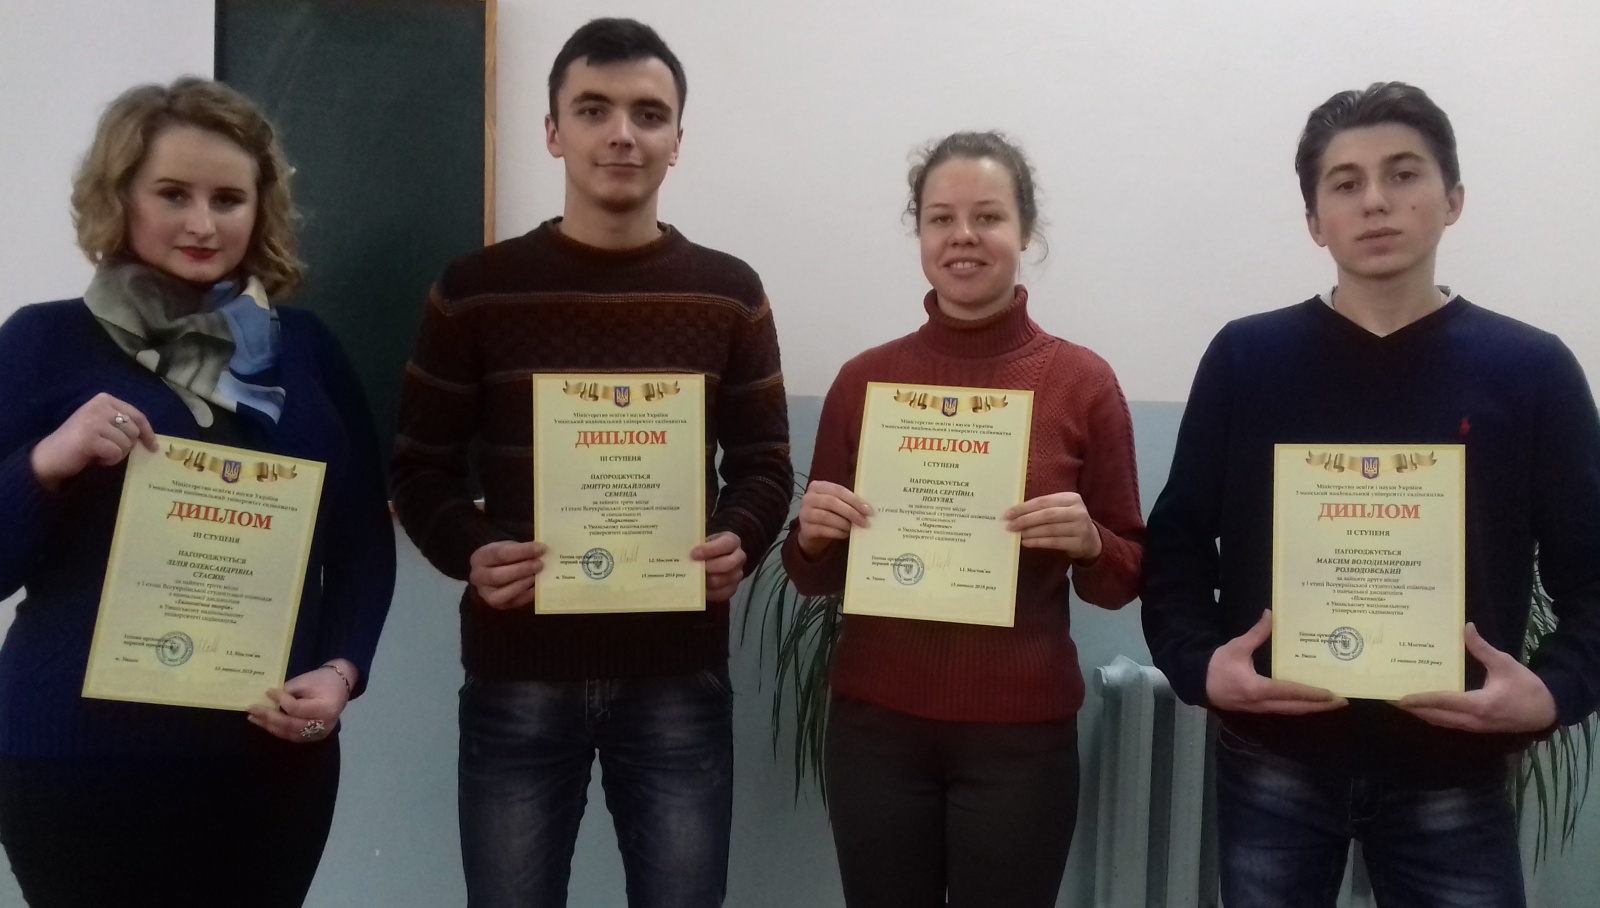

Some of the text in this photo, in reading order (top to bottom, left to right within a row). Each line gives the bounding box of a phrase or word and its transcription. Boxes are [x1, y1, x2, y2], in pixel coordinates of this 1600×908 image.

[574, 430, 667, 448] ДИПЛОМ
[897, 435, 990, 454] ДИПЛОМ
[926, 460, 959, 469] СТУПЕНЯ
[909, 477, 969, 487] НАГОРОДЖУЄТЬСЯ
[902, 486, 974, 497] КАТЕРИНА СЕРГІЇВНА
[921, 495, 953, 503] ПОЛУЛЯХ
[165, 500, 274, 530] ДИПЛОМ
[1317, 502, 1420, 521] ДИПЛОМ
